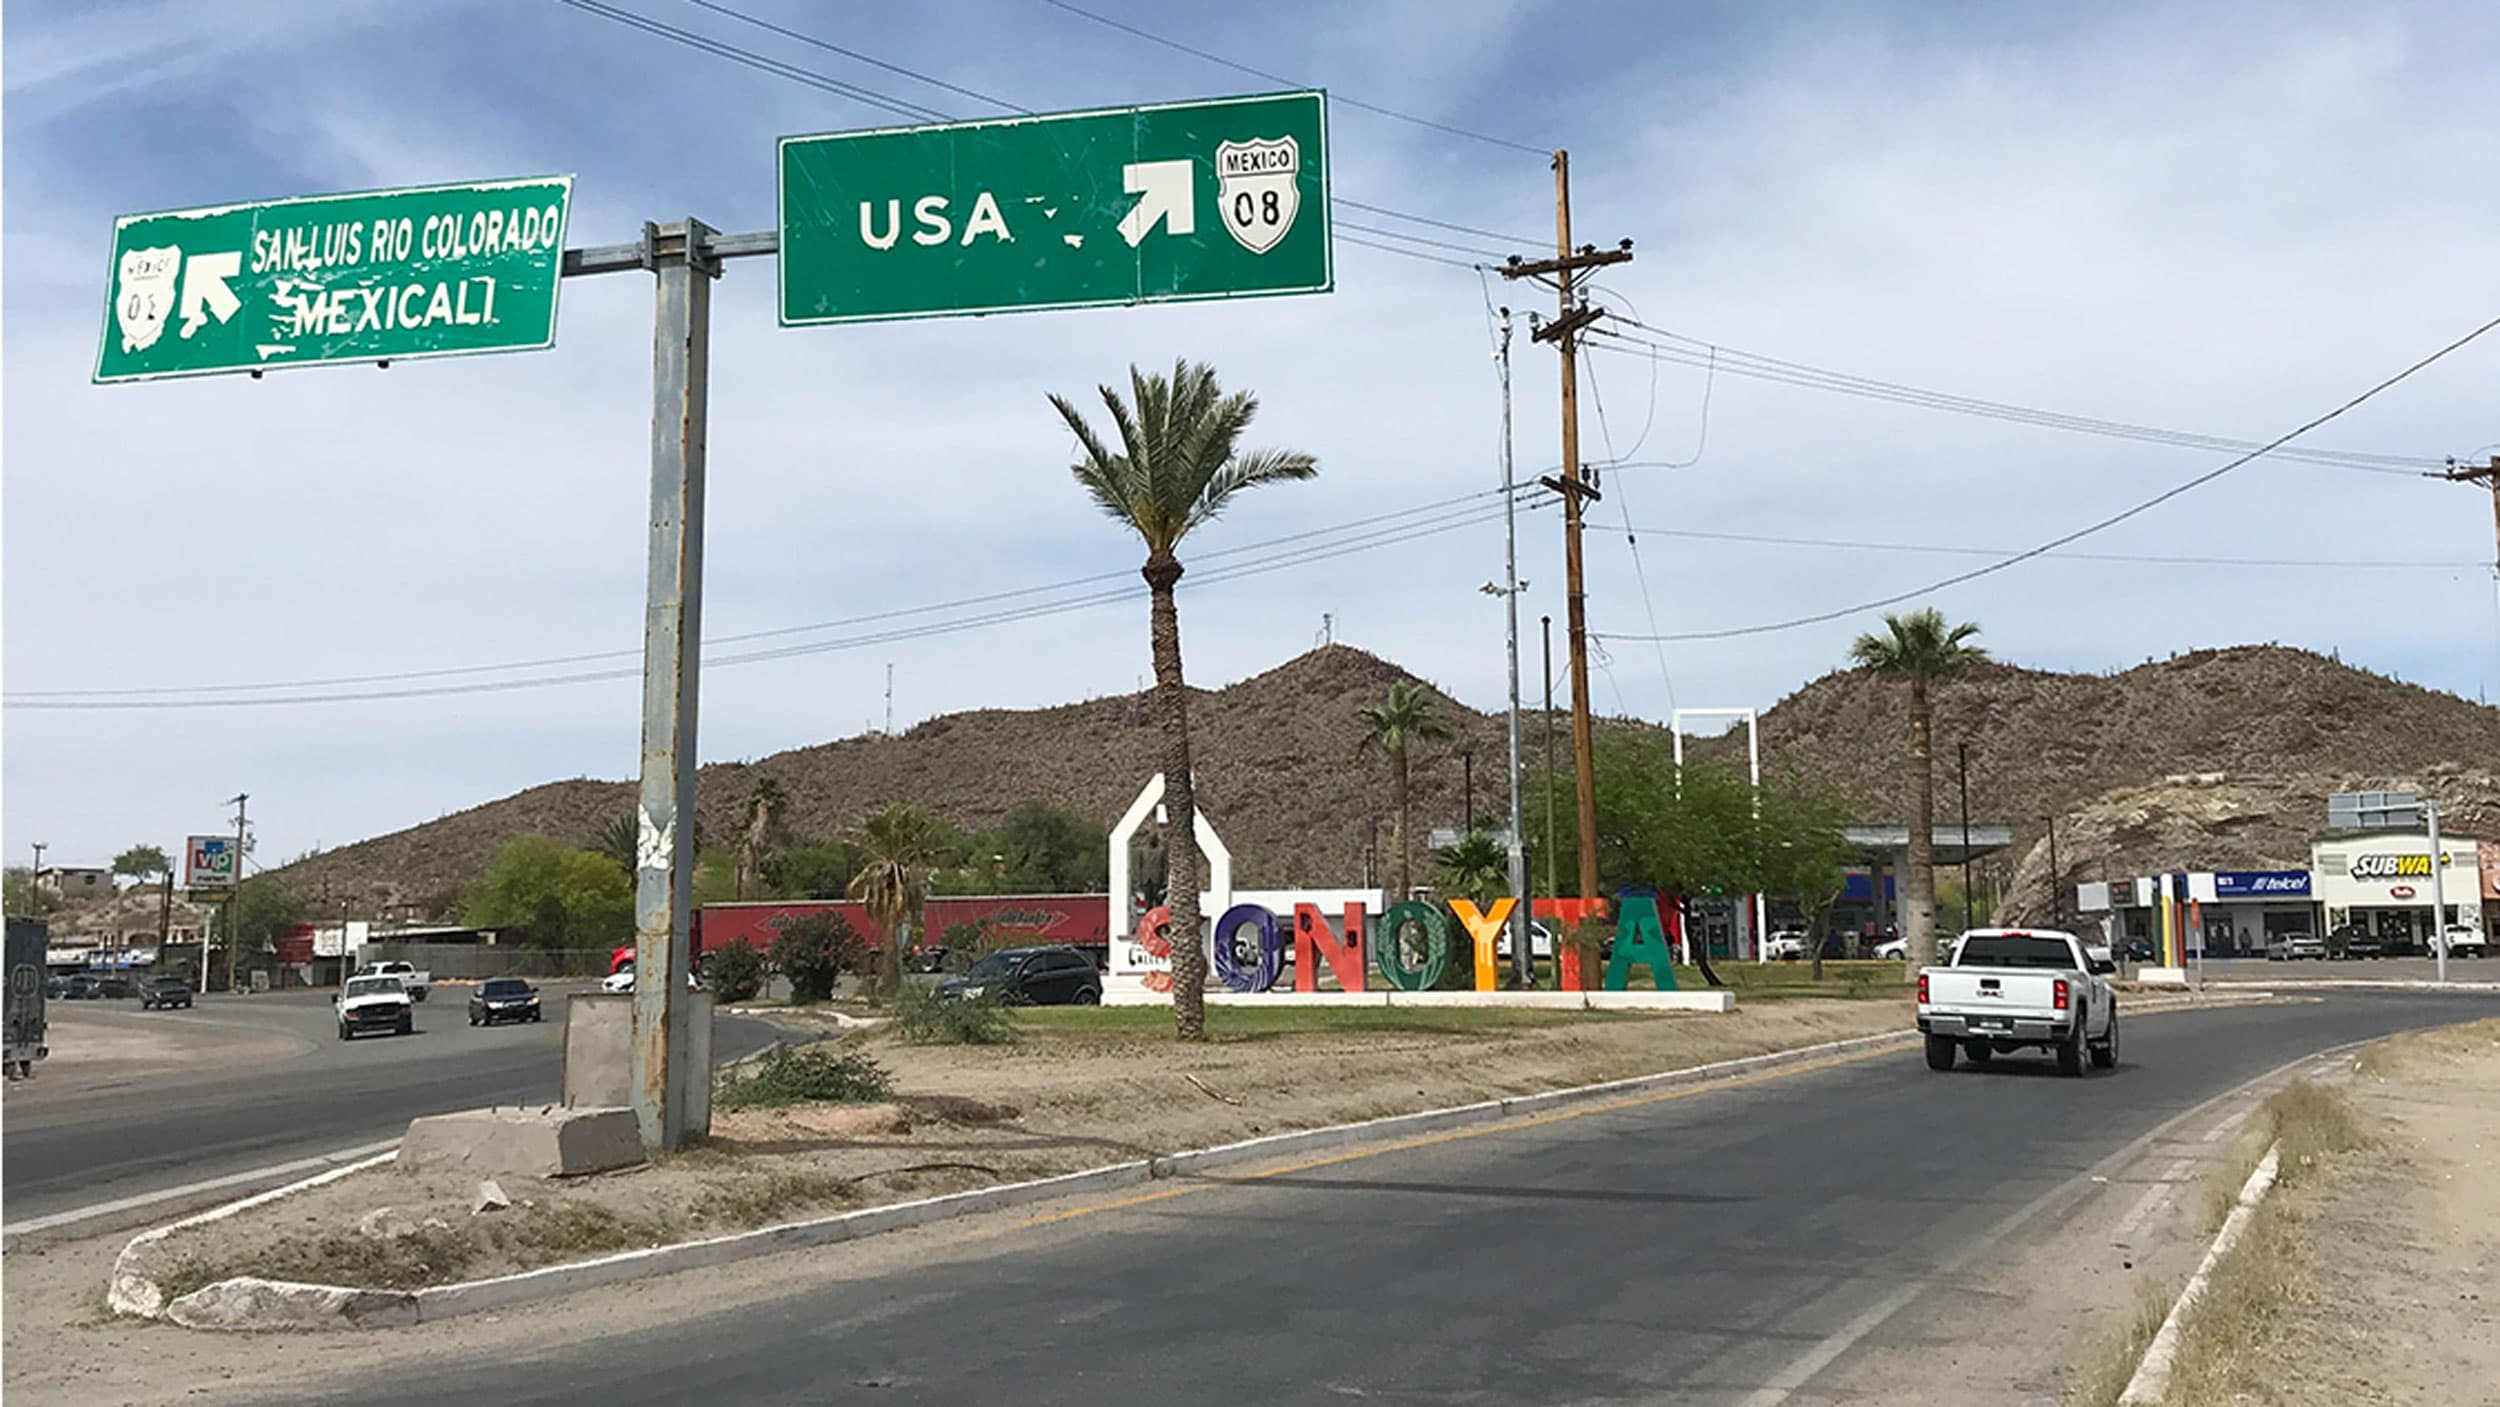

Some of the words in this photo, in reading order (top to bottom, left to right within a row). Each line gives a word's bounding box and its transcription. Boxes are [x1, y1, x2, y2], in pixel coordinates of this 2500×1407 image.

[1227, 149, 1290, 171] MEXICO
[860, 192, 1012, 250] USA
[1235, 190, 1280, 227] 08
[251, 227, 304, 273] SAN
[302, 221, 364, 268] LUIS
[369, 217, 413, 263] RIO
[422, 205, 559, 259] COLORADO
[293, 276, 500, 337] MEXICALI
[2266, 875, 2308, 891] telcel
